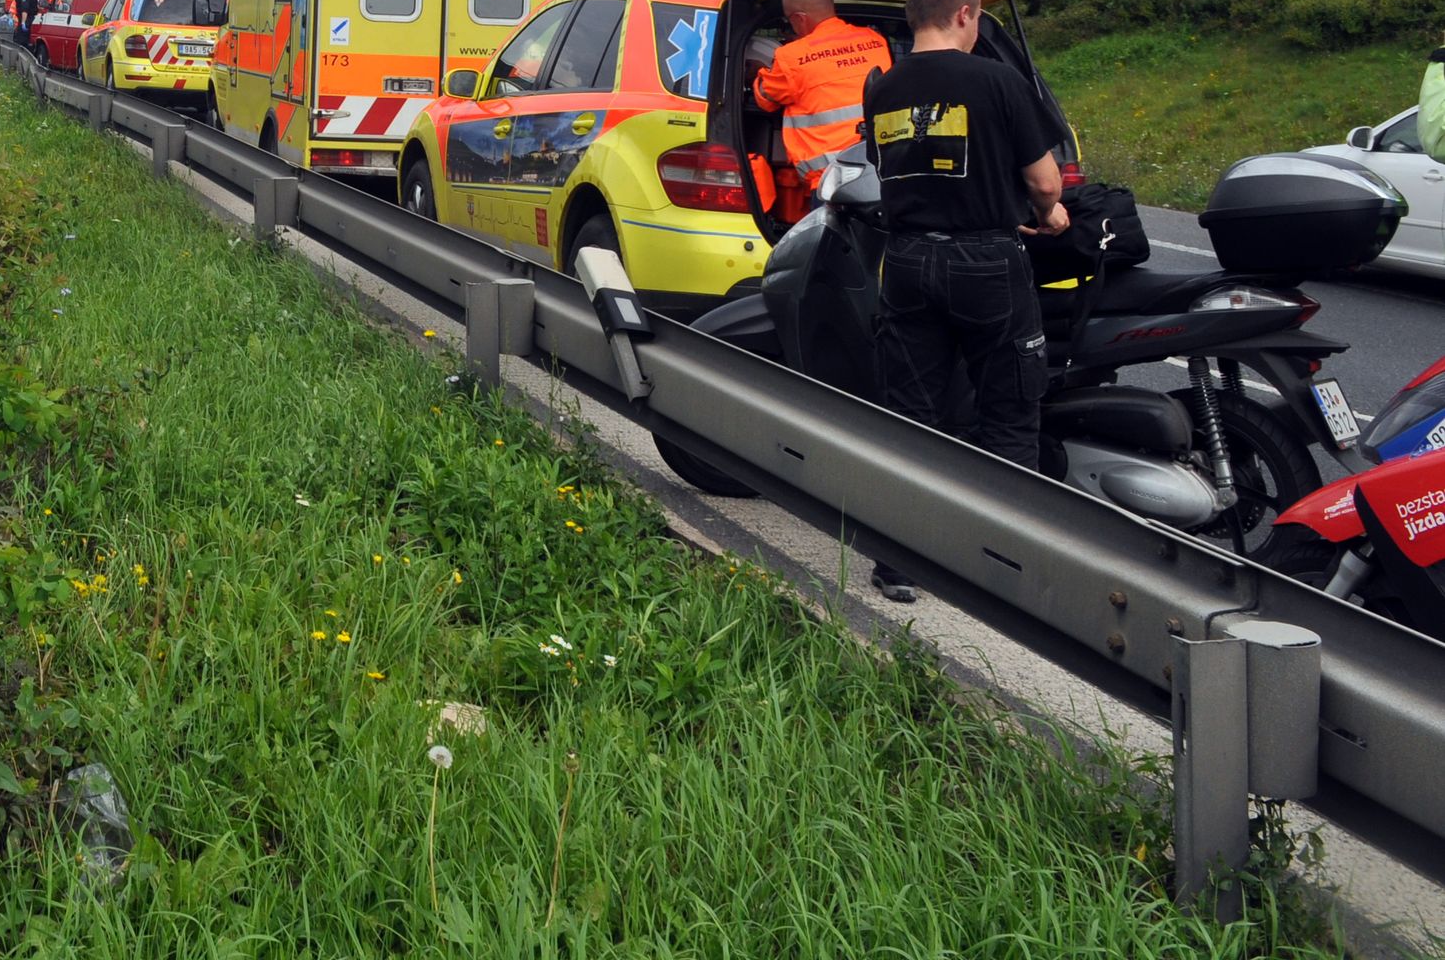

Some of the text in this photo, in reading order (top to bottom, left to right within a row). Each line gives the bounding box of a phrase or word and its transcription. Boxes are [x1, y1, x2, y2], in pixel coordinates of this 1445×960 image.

[143, 26, 153, 34] 25
[322, 54, 349, 67] 173
[797, 43, 856, 66] ZÁCHRANNÁ
[836, 55, 868, 68] PRAHA
[1326, 411, 1354, 436] 0512
[1395, 488, 1445, 518] bezsta
[1403, 511, 1445, 541] jízda
